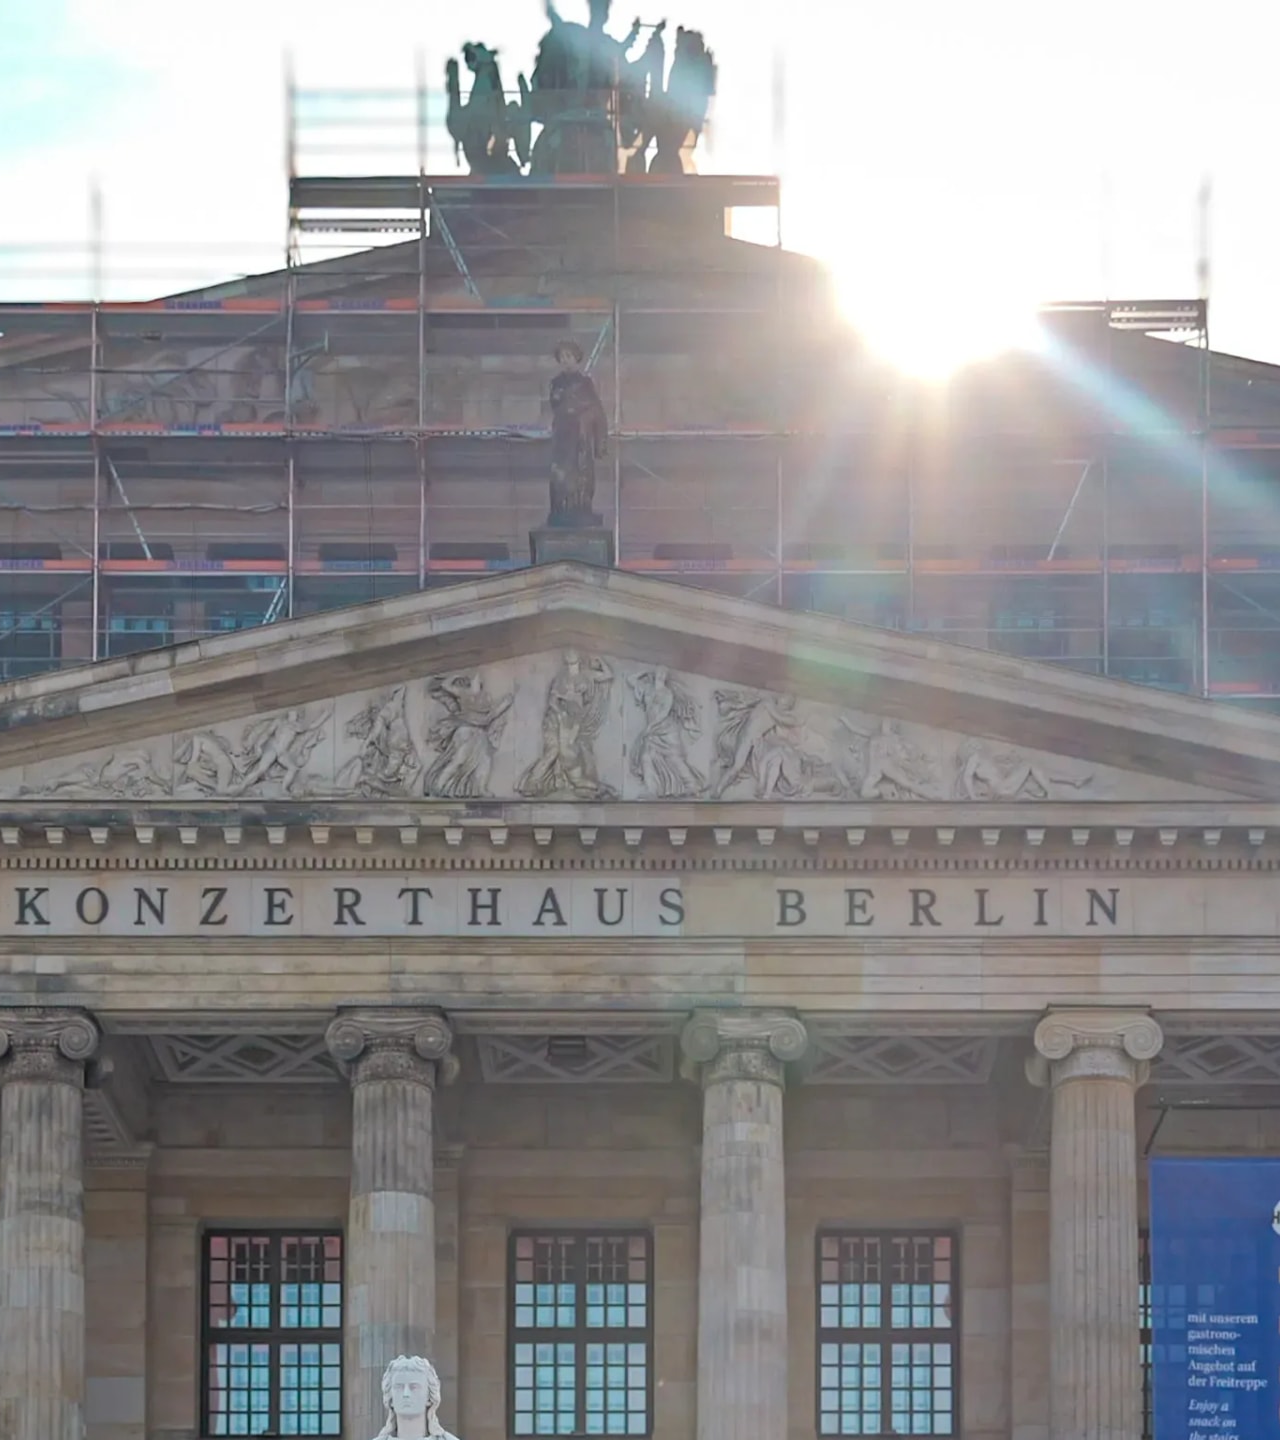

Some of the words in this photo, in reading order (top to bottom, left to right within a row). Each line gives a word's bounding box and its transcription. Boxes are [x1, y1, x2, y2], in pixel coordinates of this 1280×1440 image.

[14, 886, 686, 928] KONZERTHAUS
[776, 886, 1121, 928] BERLIN
[1187, 1312, 1207, 1323] mit
[1209, 1314, 1259, 1324] unserem
[1188, 1360, 1235, 1374] Angebot
[1236, 1360, 1257, 1372] auf
[1188, 1375, 1207, 1387] der
[1209, 1376, 1268, 1391] Freitreppe
[1189, 1399, 1218, 1414] Enjoy
